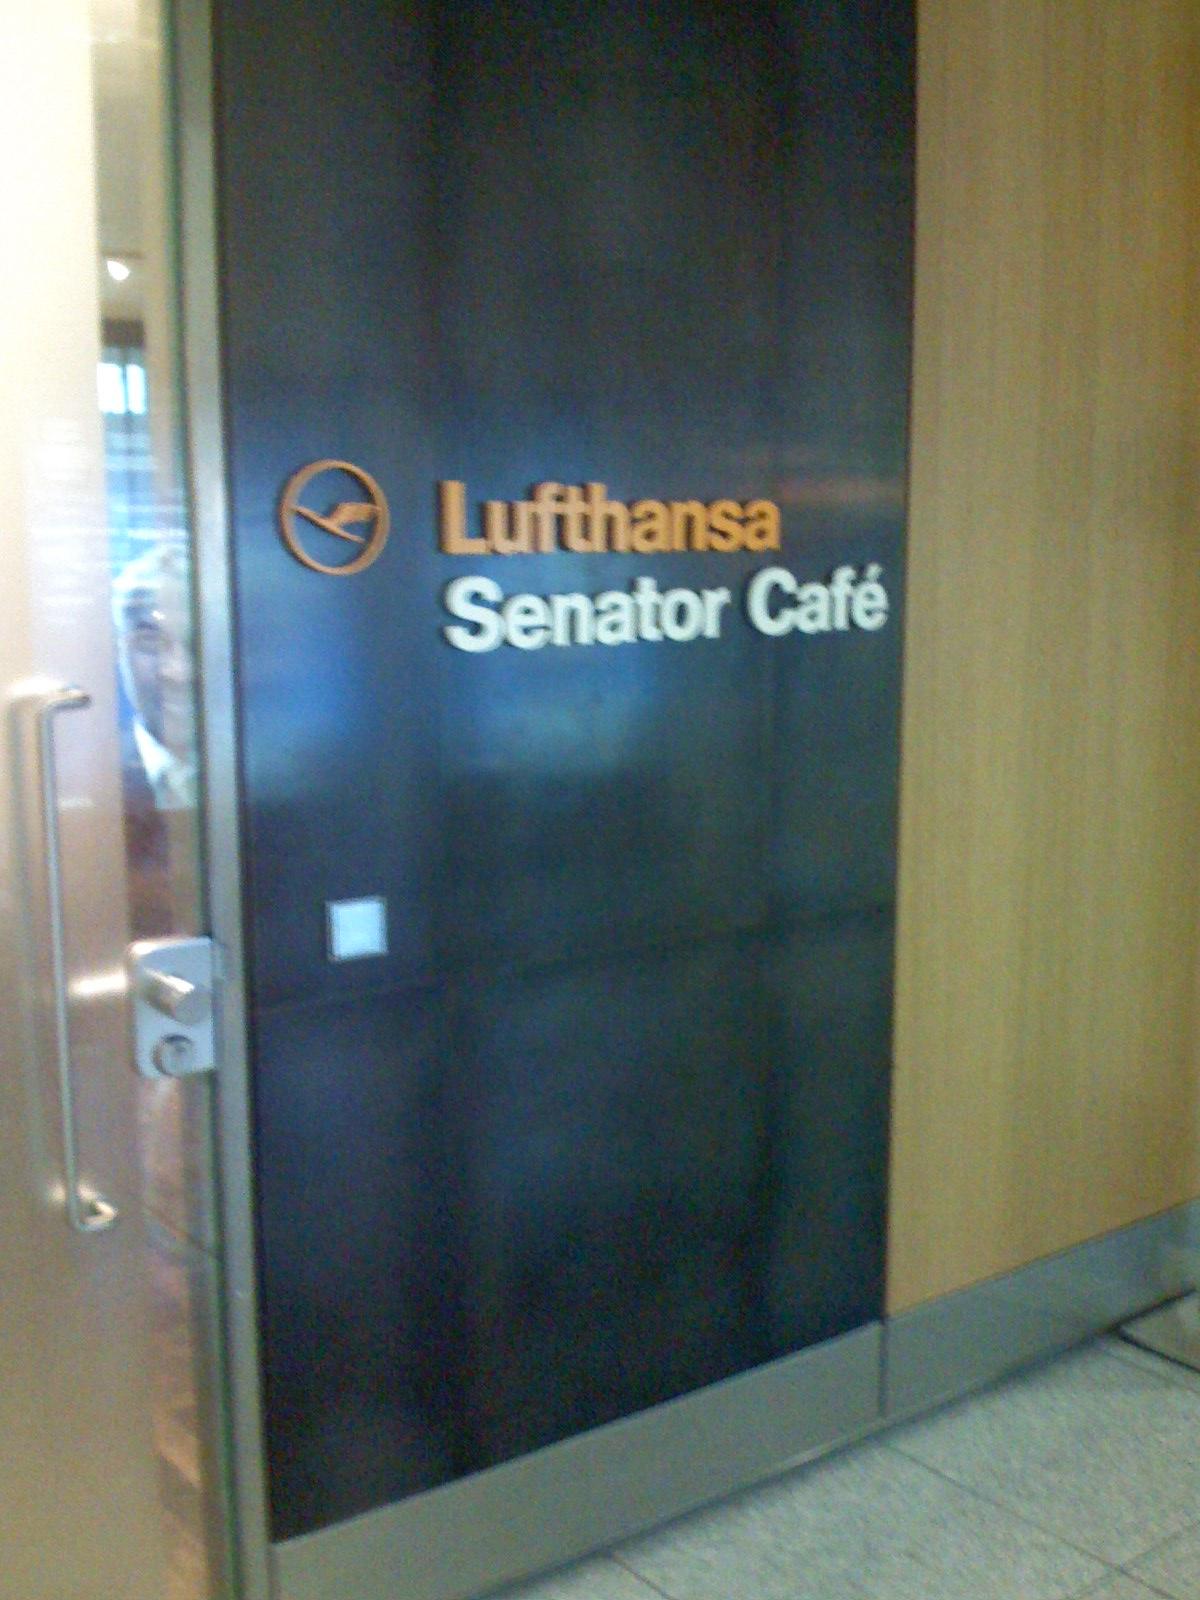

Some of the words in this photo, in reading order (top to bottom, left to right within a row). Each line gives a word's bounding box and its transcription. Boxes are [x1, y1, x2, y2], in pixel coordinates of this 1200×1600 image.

[439, 480, 781, 556] Lufthansa
[444, 575, 731, 652] Senator
[747, 562, 889, 637] Café
